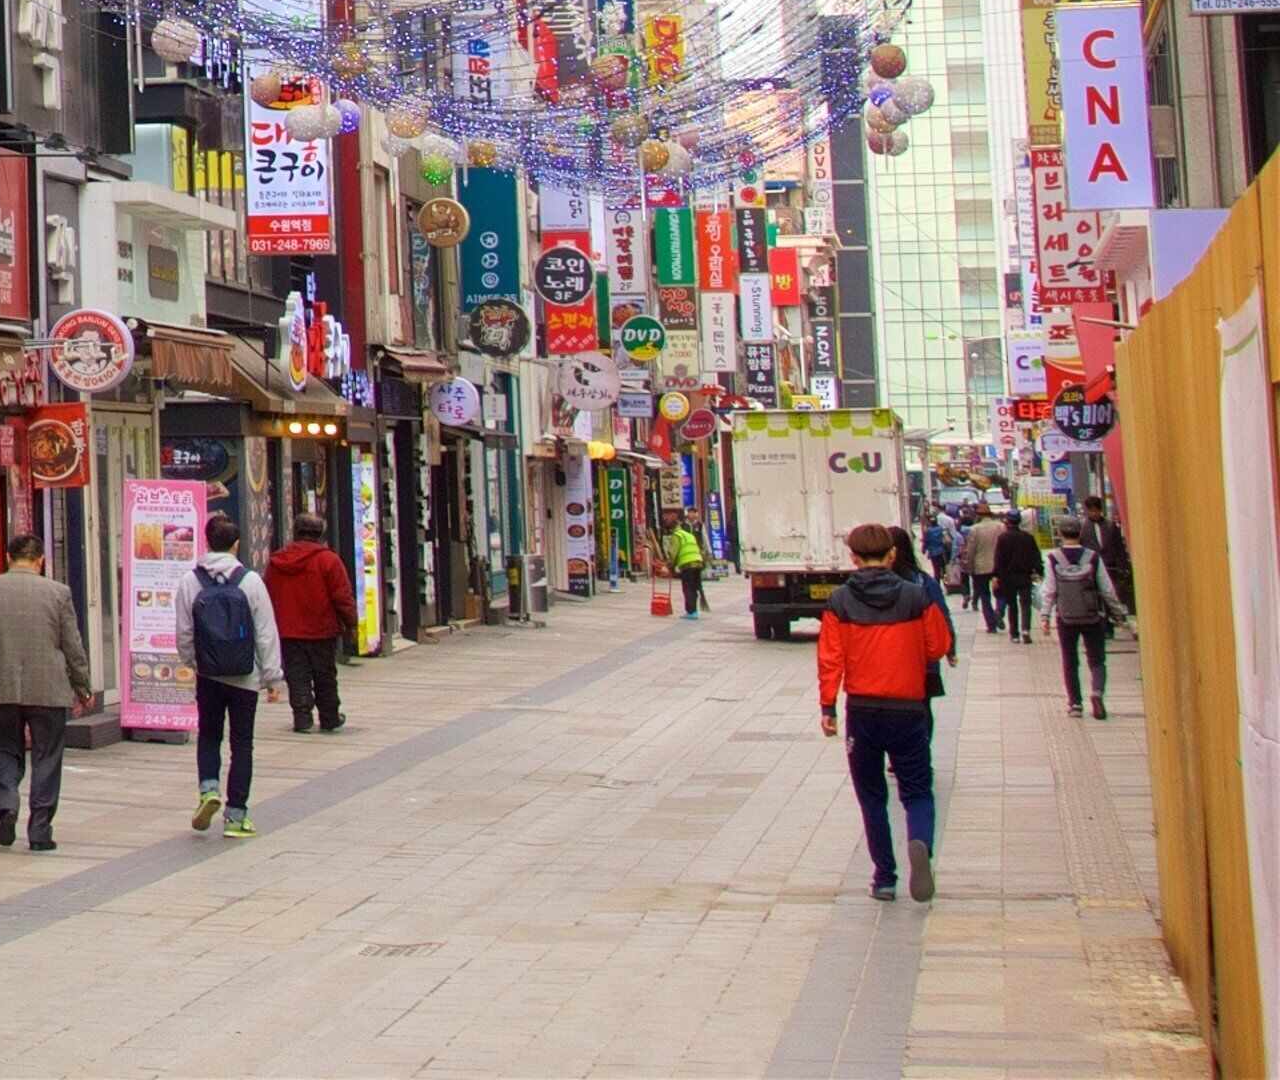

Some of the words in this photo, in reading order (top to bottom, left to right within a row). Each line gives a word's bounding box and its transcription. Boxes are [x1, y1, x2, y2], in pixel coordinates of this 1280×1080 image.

[1080, 29, 1129, 184] CNA
[253, 149, 325, 185] 큰구이
[268, 219, 313, 233] 수원역점
[251, 238, 331, 252] 031-248-7969
[543, 256, 585, 274] 코인
[708, 245, 724, 288] 오락실
[543, 275, 585, 292] 노래
[619, 281, 633, 291] 2F
[554, 290, 573, 301] 3F
[623, 327, 661, 342] DVD
[663, 376, 699, 389] DVD
[748, 384, 774, 394] Pizza
[1078, 428, 1093, 439] 2F
[828, 451, 882, 474] CU
[135, 488, 194, 506] 러브스토리
[610, 477, 623, 520] DVD
